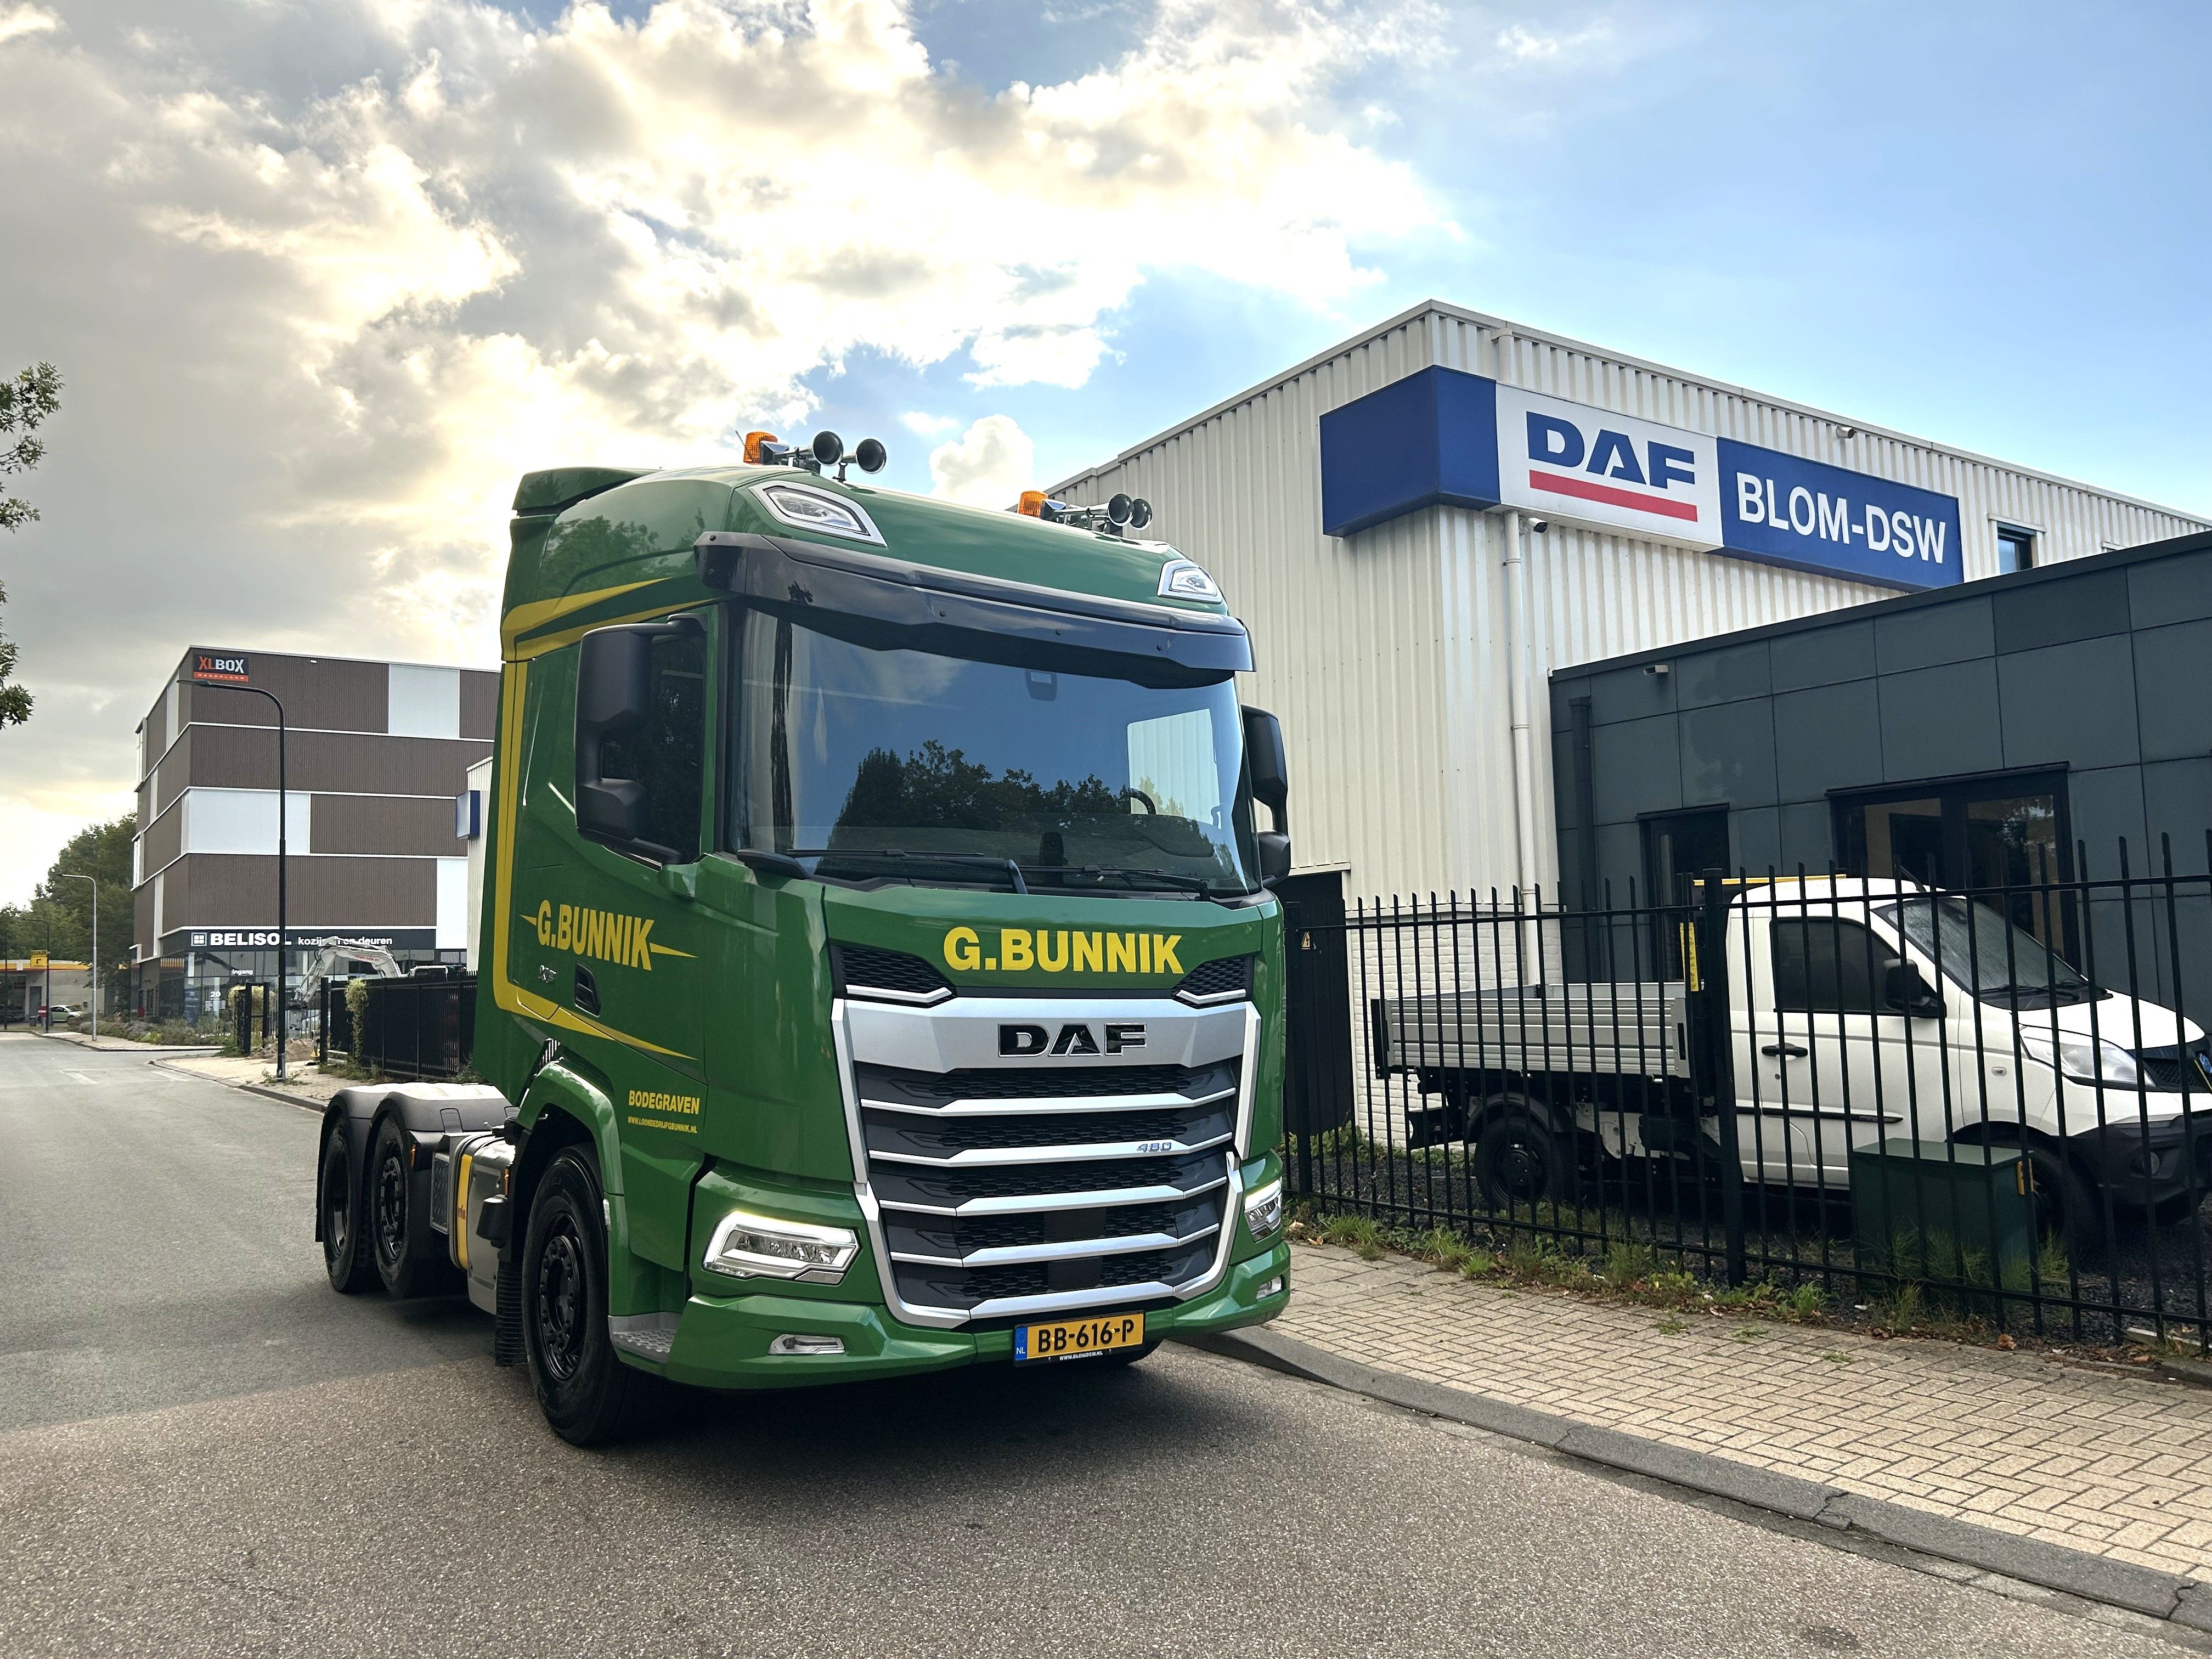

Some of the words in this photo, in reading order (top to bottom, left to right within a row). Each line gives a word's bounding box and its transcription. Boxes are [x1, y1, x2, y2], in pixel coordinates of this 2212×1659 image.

[1526, 411, 1695, 489] DAF
[1736, 472, 1946, 565] BLOM-DSW
[199, 656, 244, 674] XLBOX
[358, 936, 392, 945] deuren
[537, 899, 654, 971] G.BUNNIK
[943, 927, 1184, 974] G.BUNNIK
[997, 1023, 1147, 1057] DAF
[628, 1090, 700, 1115] BODEGRAVEN
[1137, 1142, 1172, 1153] 480
[1016, 1347, 1026, 1355] NL
[1038, 1319, 1135, 1353] BB-616-P
